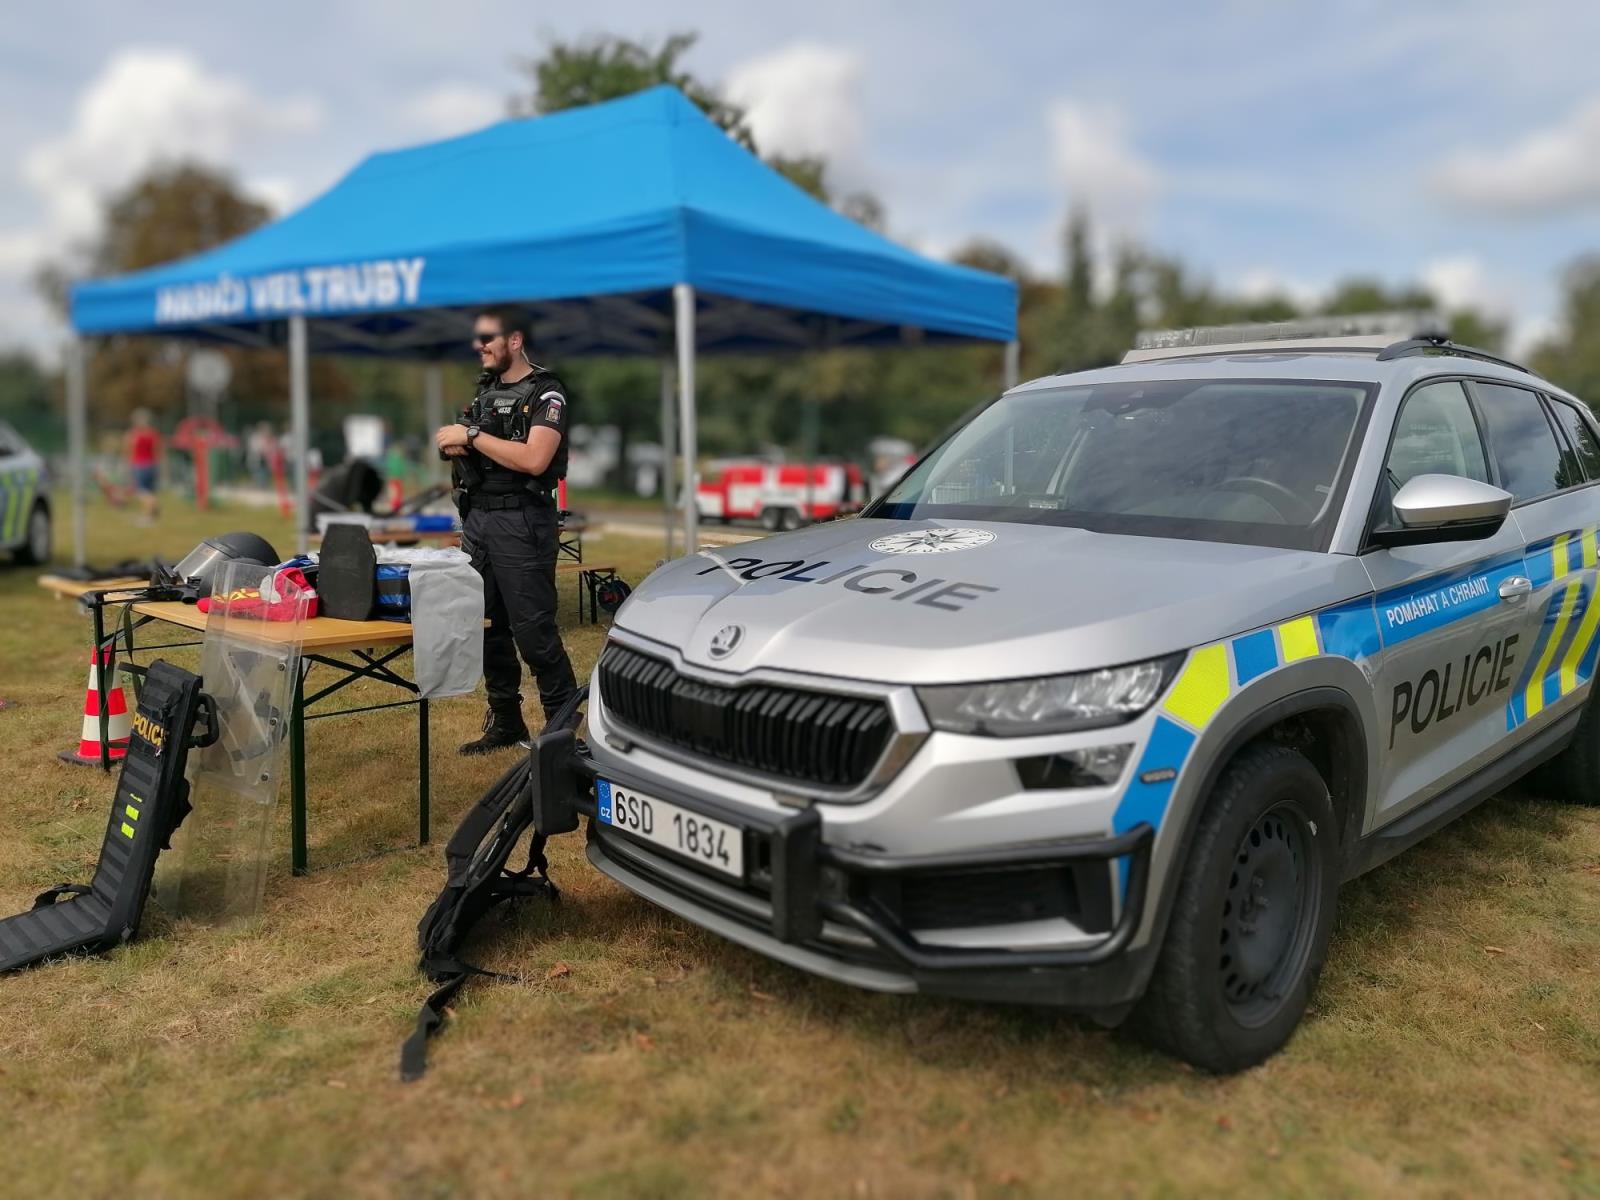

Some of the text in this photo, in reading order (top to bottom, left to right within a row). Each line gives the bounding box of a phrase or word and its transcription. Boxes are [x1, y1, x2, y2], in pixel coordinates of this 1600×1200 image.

[696, 557, 1000, 612] POLICIE
[1386, 576, 1490, 628] POMÁHAT A CHRÁNIT
[1388, 633, 1520, 751] POLICIE
[600, 806, 611, 819] CZ
[615, 791, 730, 867] 6SD 1834
